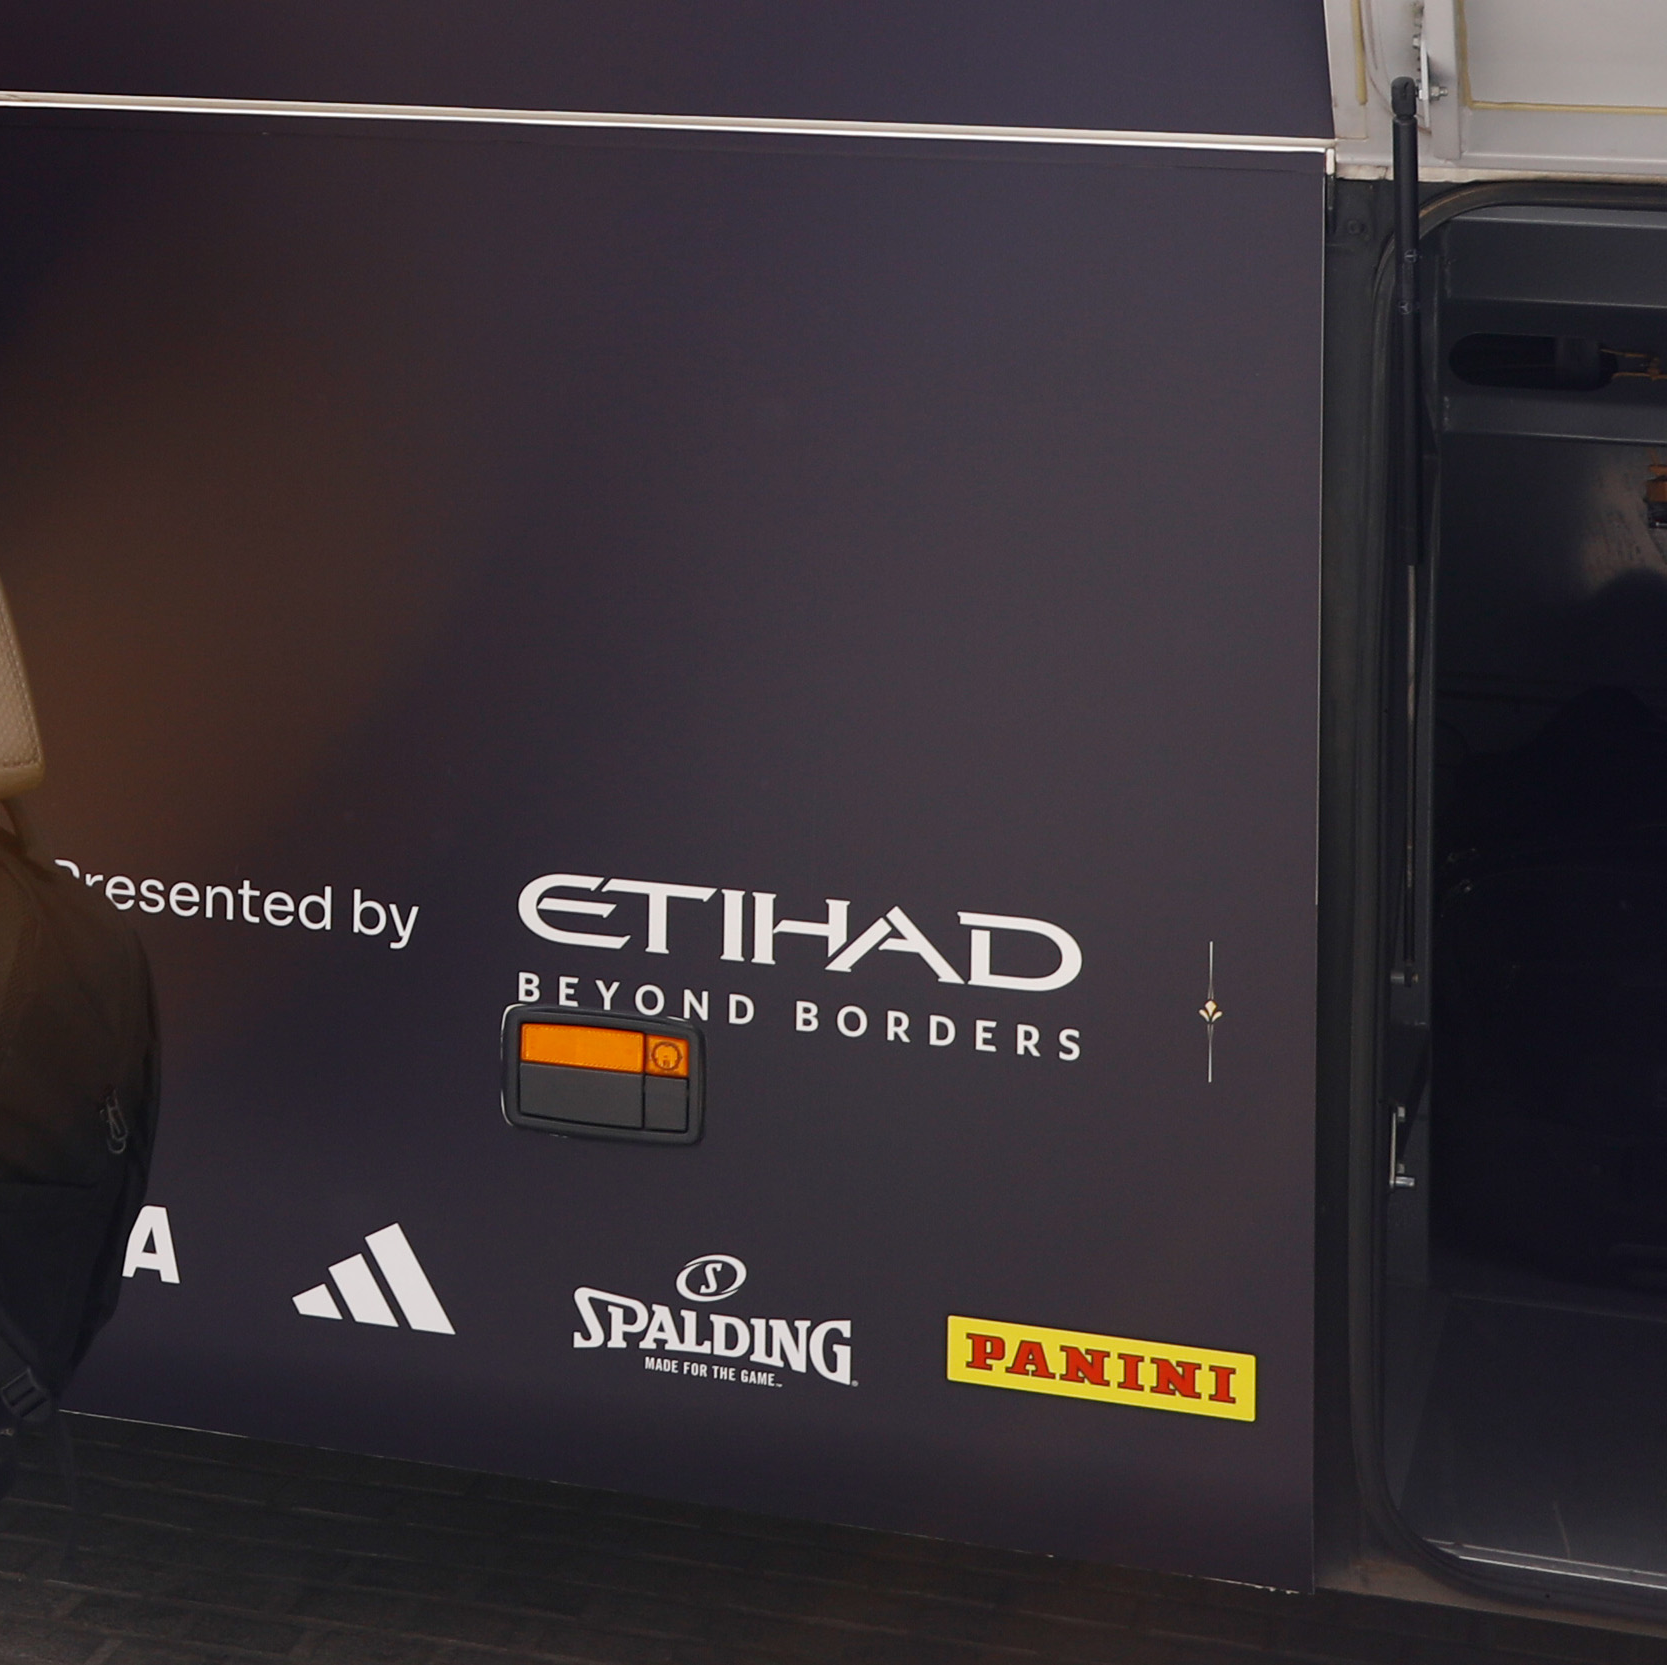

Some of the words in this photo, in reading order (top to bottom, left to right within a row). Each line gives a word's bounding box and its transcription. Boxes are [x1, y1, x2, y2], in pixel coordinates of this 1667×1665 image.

[352, 888, 419, 950] by
[518, 873, 1082, 992] ETIHAD
[518, 971, 755, 1025] BEYOND
[795, 1000, 1081, 1061] BORDERS
[573, 1286, 854, 1386] SPALDING
[645, 1356, 678, 1374] MADE
[683, 1362, 708, 1378] FOR
[712, 1365, 736, 1381] THE
[966, 1333, 1236, 1404] PANINI
